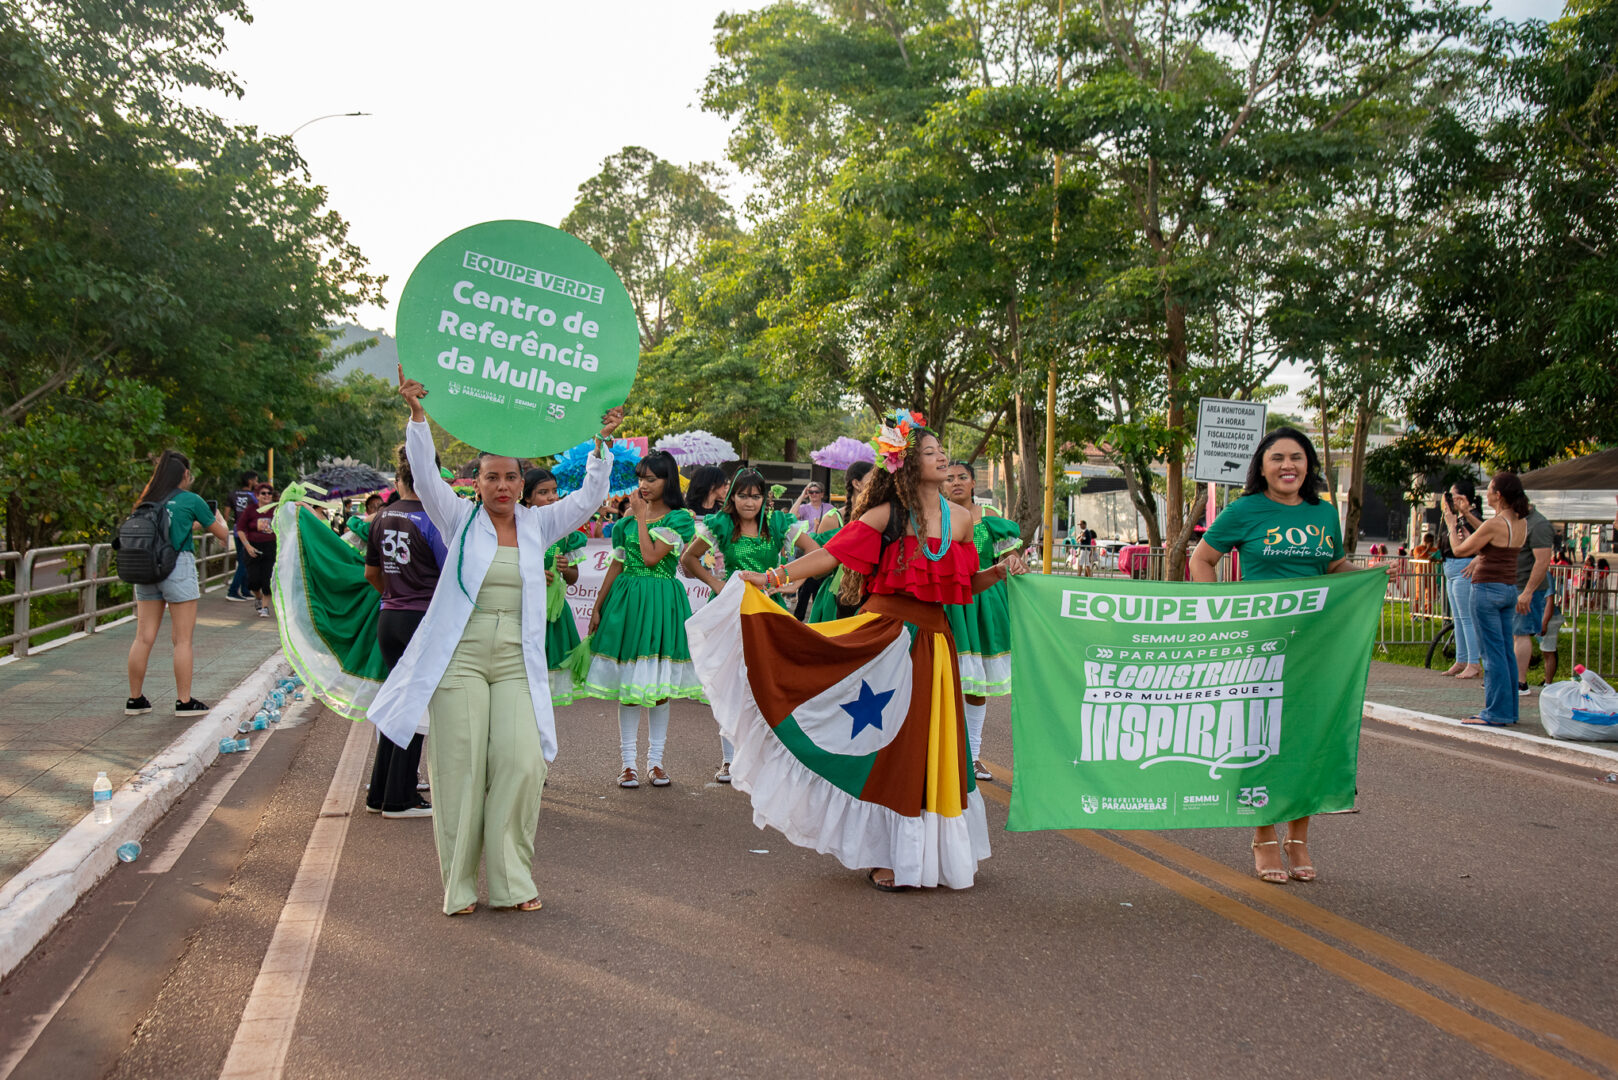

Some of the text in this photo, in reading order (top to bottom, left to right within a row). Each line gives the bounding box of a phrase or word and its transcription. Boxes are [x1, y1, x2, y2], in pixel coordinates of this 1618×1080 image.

[466, 252, 602, 301] EQUIPE VERDE
[453, 280, 599, 338] Centro de
[437, 310, 599, 372] Referência
[437, 347, 587, 402] da Mulher
[515, 398, 537, 408] SEMMU
[1222, 406, 1255, 416] MONITORADA
[1217, 417, 1245, 426] 24 HORAS
[1208, 431, 1245, 441] FISCALIZAÇÃO
[1211, 440, 1250, 451] TRÂNSITO POR
[1263, 524, 1334, 549] 50%
[1068, 590, 1321, 622] EQUIPE VERDE
[1132, 630, 1249, 644] SEMMU 20 ANOS
[1119, 644, 1255, 660] PARAUAPEBAS
[1104, 686, 1260, 701] POR MULHERES QUE
[1080, 698, 1284, 762] INSPIRAM
[1102, 802, 1168, 810] PARAUAPEBAS
[1183, 794, 1220, 804] SEMMU
